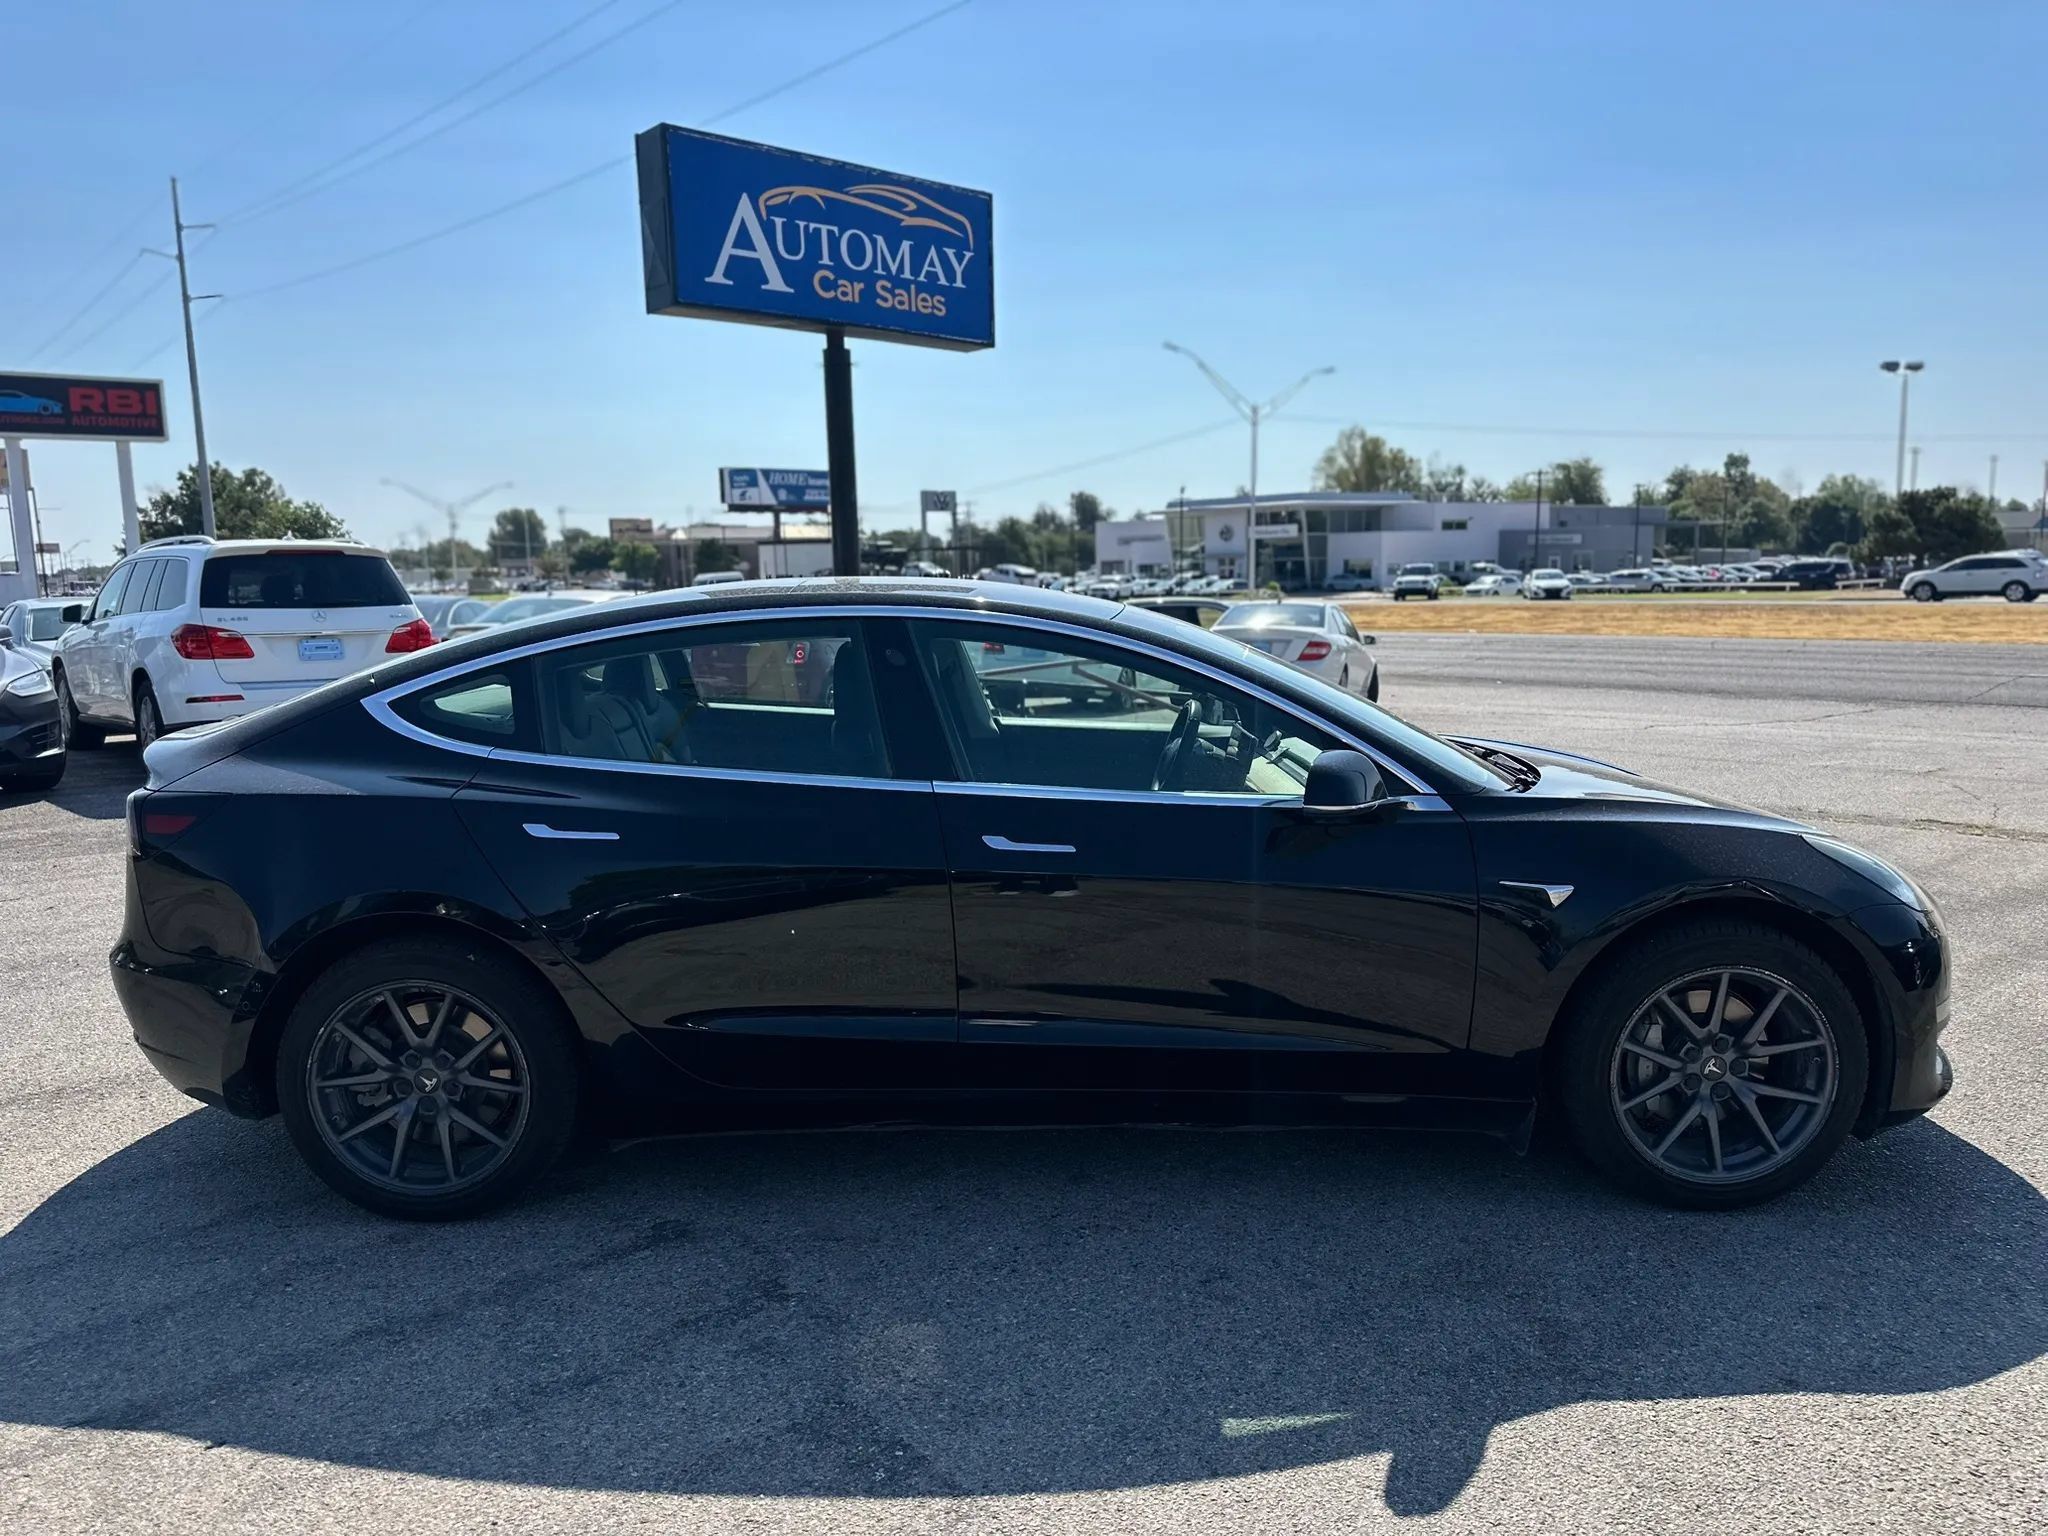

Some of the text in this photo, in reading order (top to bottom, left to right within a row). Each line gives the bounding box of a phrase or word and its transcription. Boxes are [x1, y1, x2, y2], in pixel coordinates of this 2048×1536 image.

[704, 192, 975, 294] AUTOMAY
[812, 270, 947, 317] Car Sales
[68, 387, 158, 416] RBI
[73, 416, 158, 428] AUTOMOTIVE
[769, 472, 809, 486] HOME
